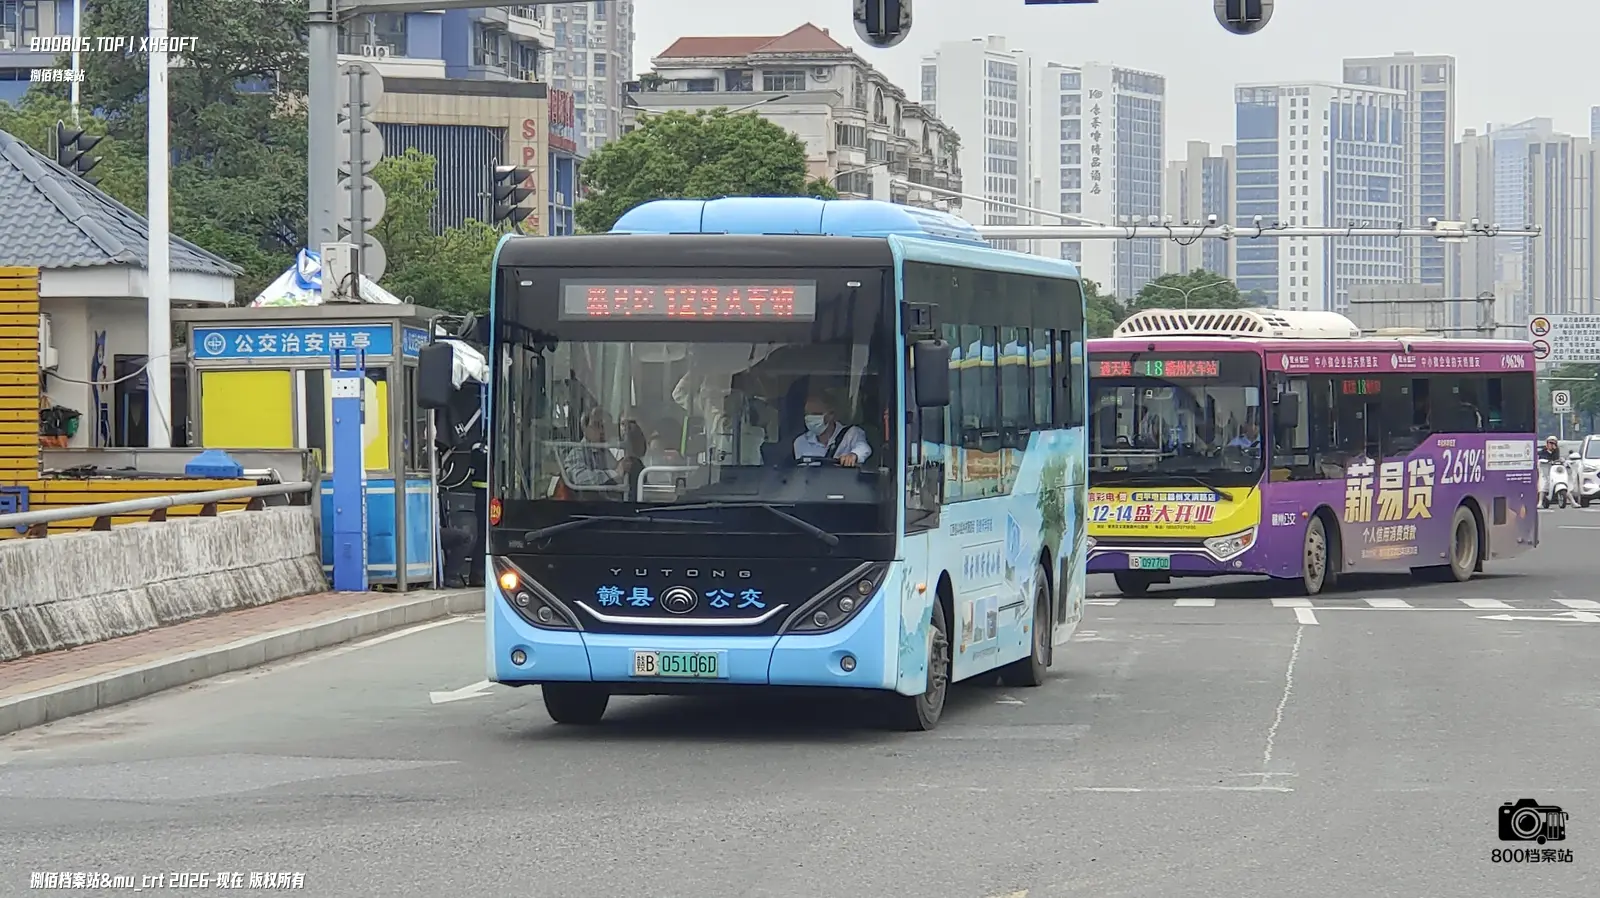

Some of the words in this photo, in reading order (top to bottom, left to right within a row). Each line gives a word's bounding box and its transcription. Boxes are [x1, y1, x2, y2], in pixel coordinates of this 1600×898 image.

[664, 287, 719, 317] 129
[234, 331, 371, 353] 公交治安岗亭
[1100, 361, 1132, 376] 通天岩
[1144, 360, 1163, 376] 18
[1165, 360, 1218, 376] 赣州火车站
[1440, 448, 1482, 484] 2.61%
[1344, 457, 1436, 523] 薪易贷
[1134, 504, 1215, 522] 盛大开业
[1362, 524, 1417, 543] 个人信用消费贷款
[610, 568, 751, 578] YUTONG
[596, 585, 655, 607] 赣县
[705, 588, 767, 609] 公交
[662, 655, 717, 673] 05106D
